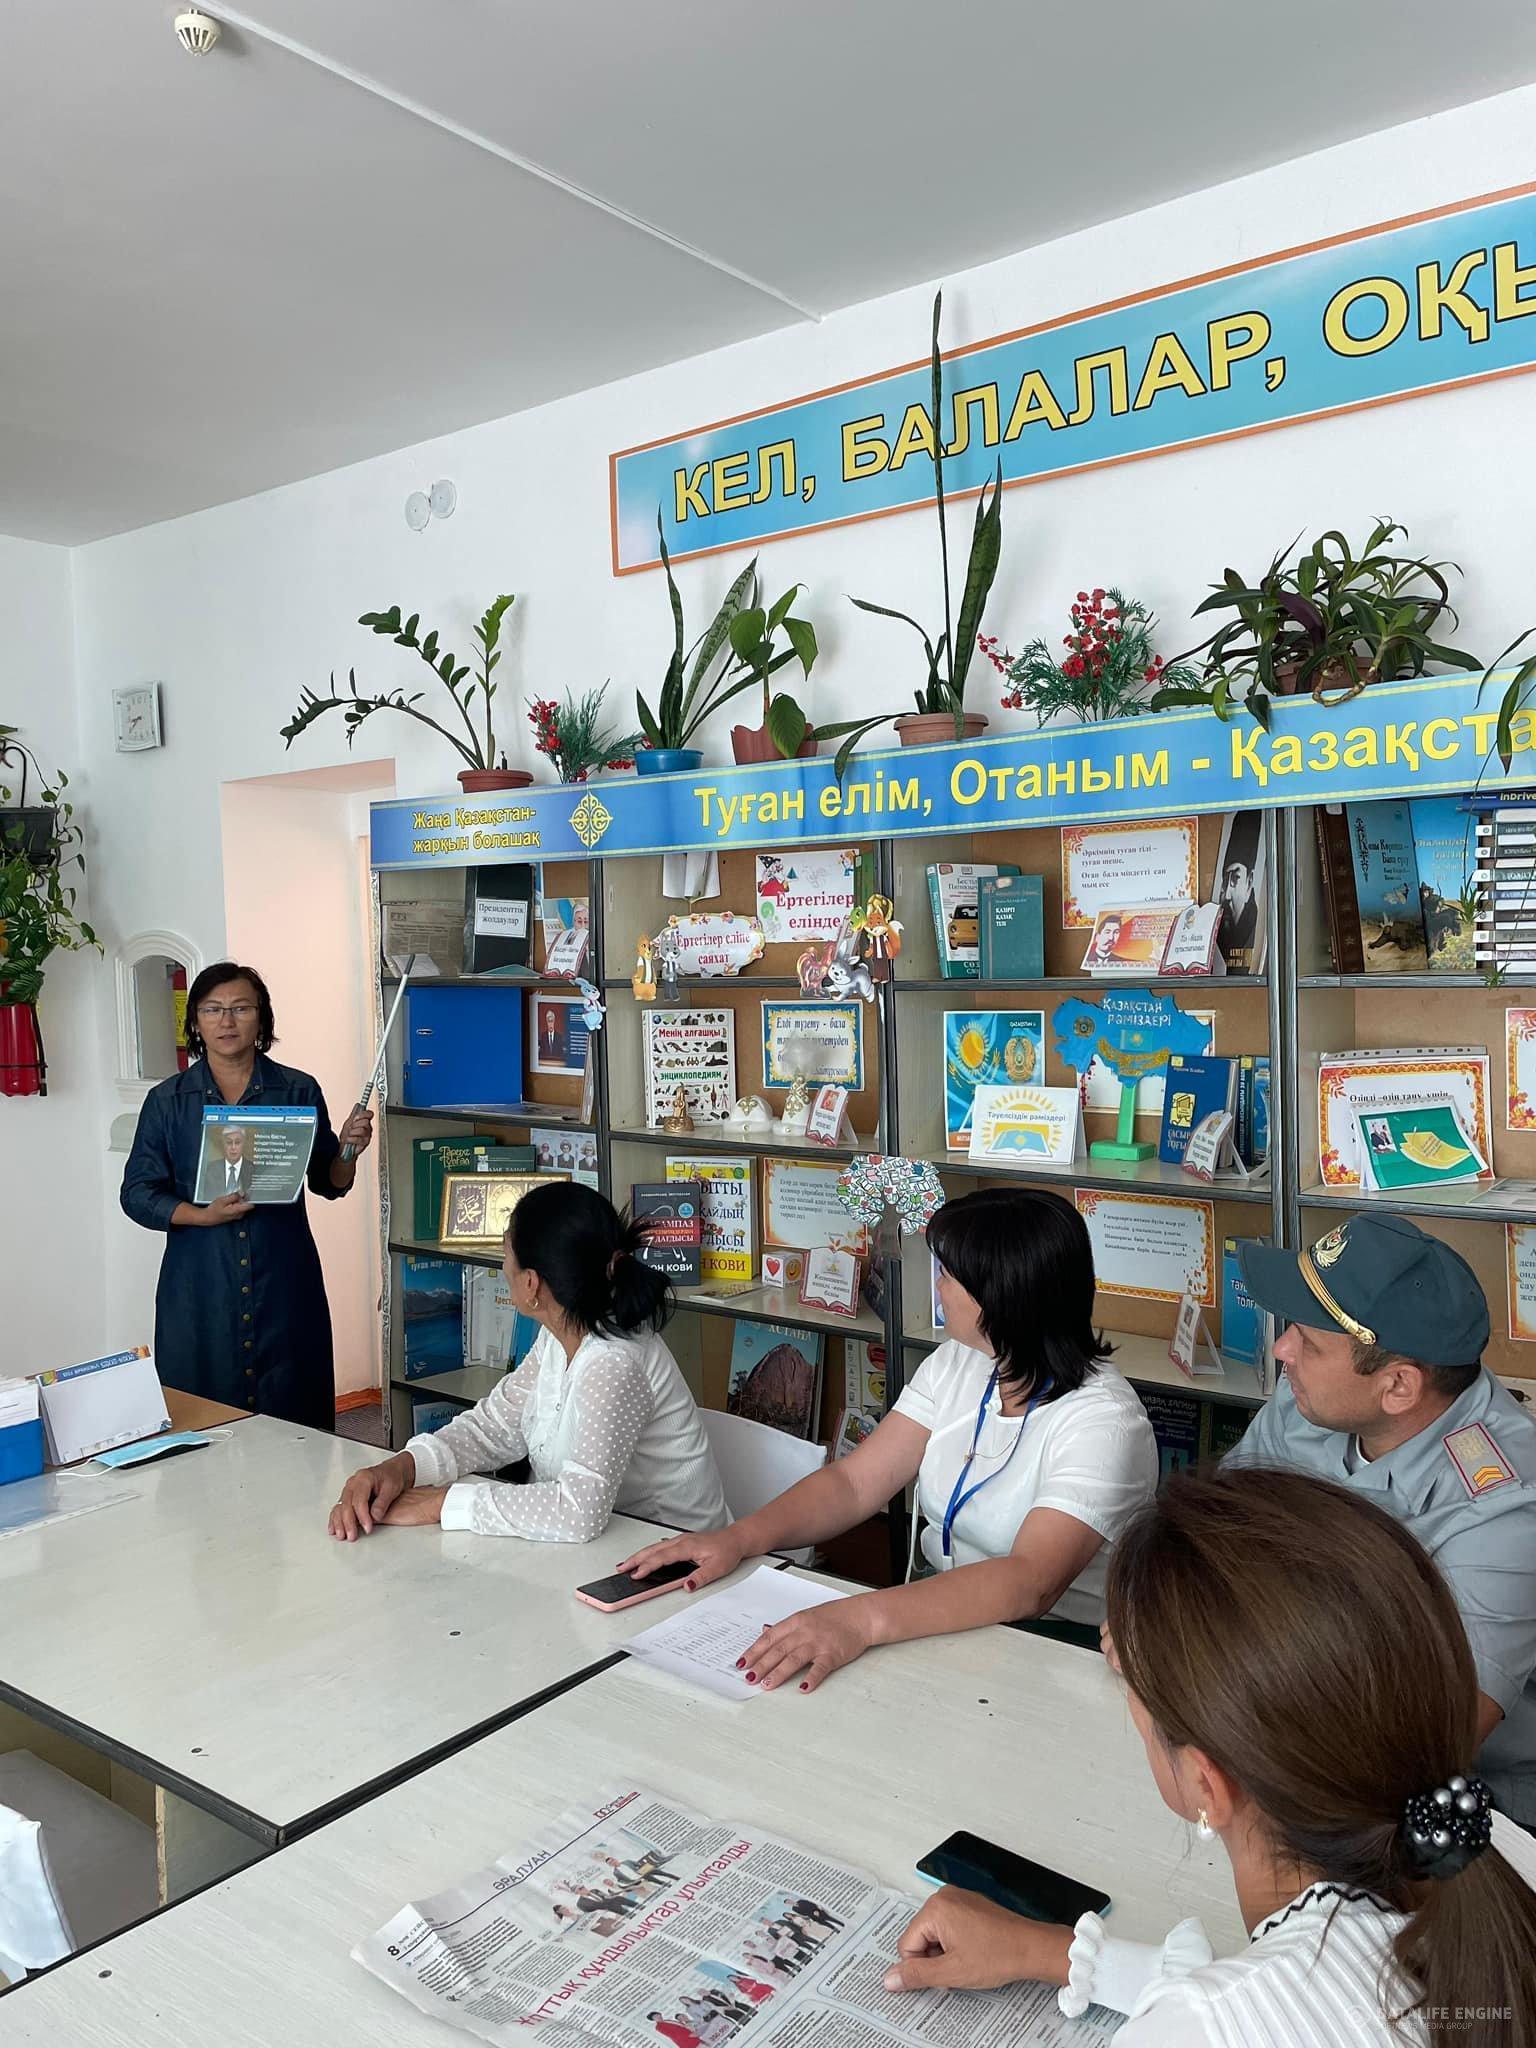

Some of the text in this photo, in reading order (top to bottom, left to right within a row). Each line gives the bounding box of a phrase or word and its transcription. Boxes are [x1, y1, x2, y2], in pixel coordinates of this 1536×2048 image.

[674, 438, 818, 522] КЕЛ,
[840, 311, 1286, 483] БАЛАЛАР,
[695, 786, 804, 837] Туған
[817, 770, 933, 819] елім,
[950, 747, 1170, 805] Отаным
[1230, 708, 1536, 788] Қазақста
[412, 806, 536, 831] Жаңа Қазақстан-
[413, 831, 541, 856] жарқын болашақ
[776, 891, 854, 908] Ертегілер
[482, 915, 520, 926] жолдаулар
[789, 914, 841, 929] елінде
[698, 953, 729, 966] саяхат
[1103, 998, 1162, 1013] ҚАЗАҚСТАН
[1107, 1014, 1171, 1027] РӘМІЗДЕРІ
[659, 1028, 720, 1039] Менің алғашқы
[988, 1111, 1066, 1122] Тәуелсіздік рәміздері
[647, 1263, 693, 1272] ОН КОВИ
[711, 1257, 746, 1271] КОВИ
[578, 1899, 681, 1980] құндылықтар
[674, 1839, 753, 1902] ұлықталды
[387, 1945, 400, 1956] 8
